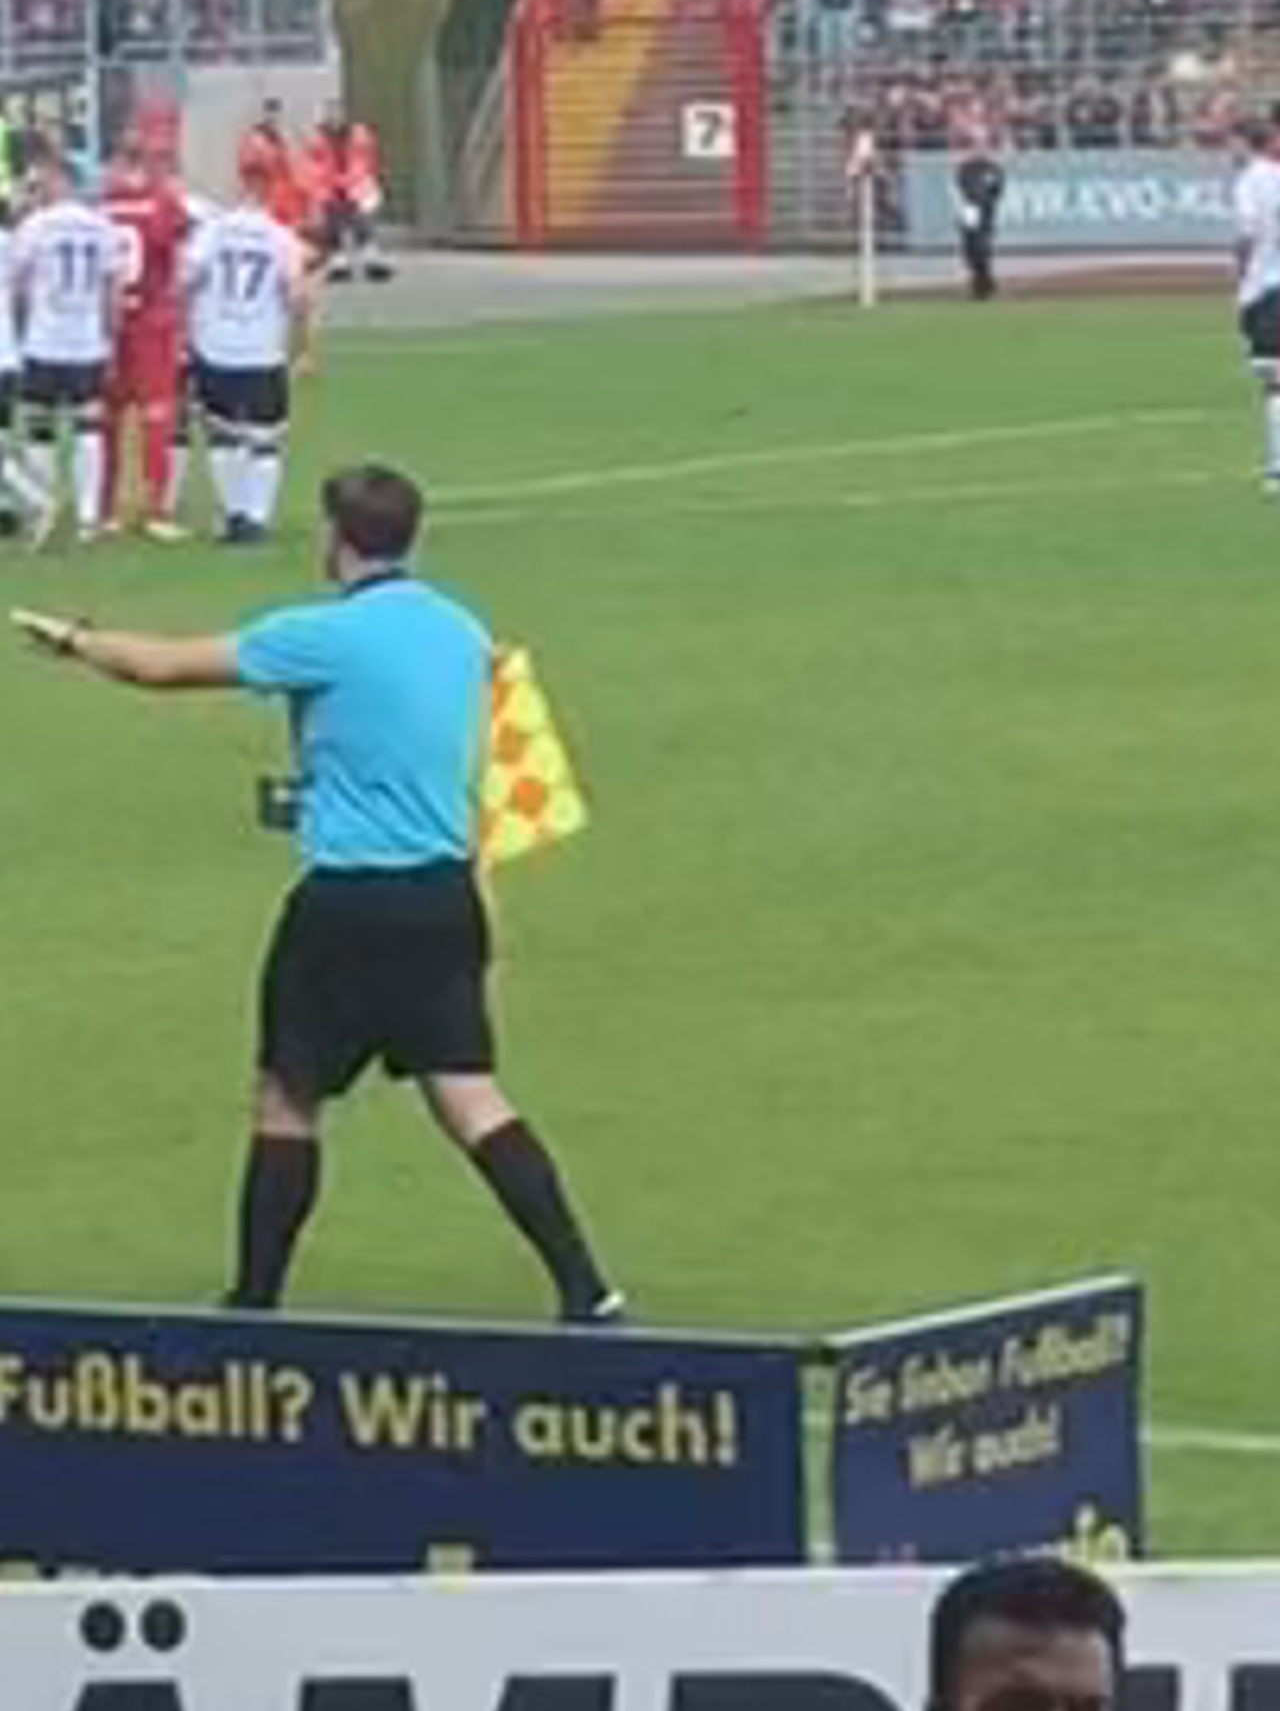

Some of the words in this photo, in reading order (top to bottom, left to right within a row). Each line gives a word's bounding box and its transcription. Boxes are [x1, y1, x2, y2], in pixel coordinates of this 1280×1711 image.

[696, 111, 721, 150] 7
[220, 248, 272, 302] 17
[340, 1373, 487, 1450] Wir
[514, 1382, 736, 1465] auch!
[845, 1365, 893, 1424] Sie
[908, 1425, 965, 1491] Wir
